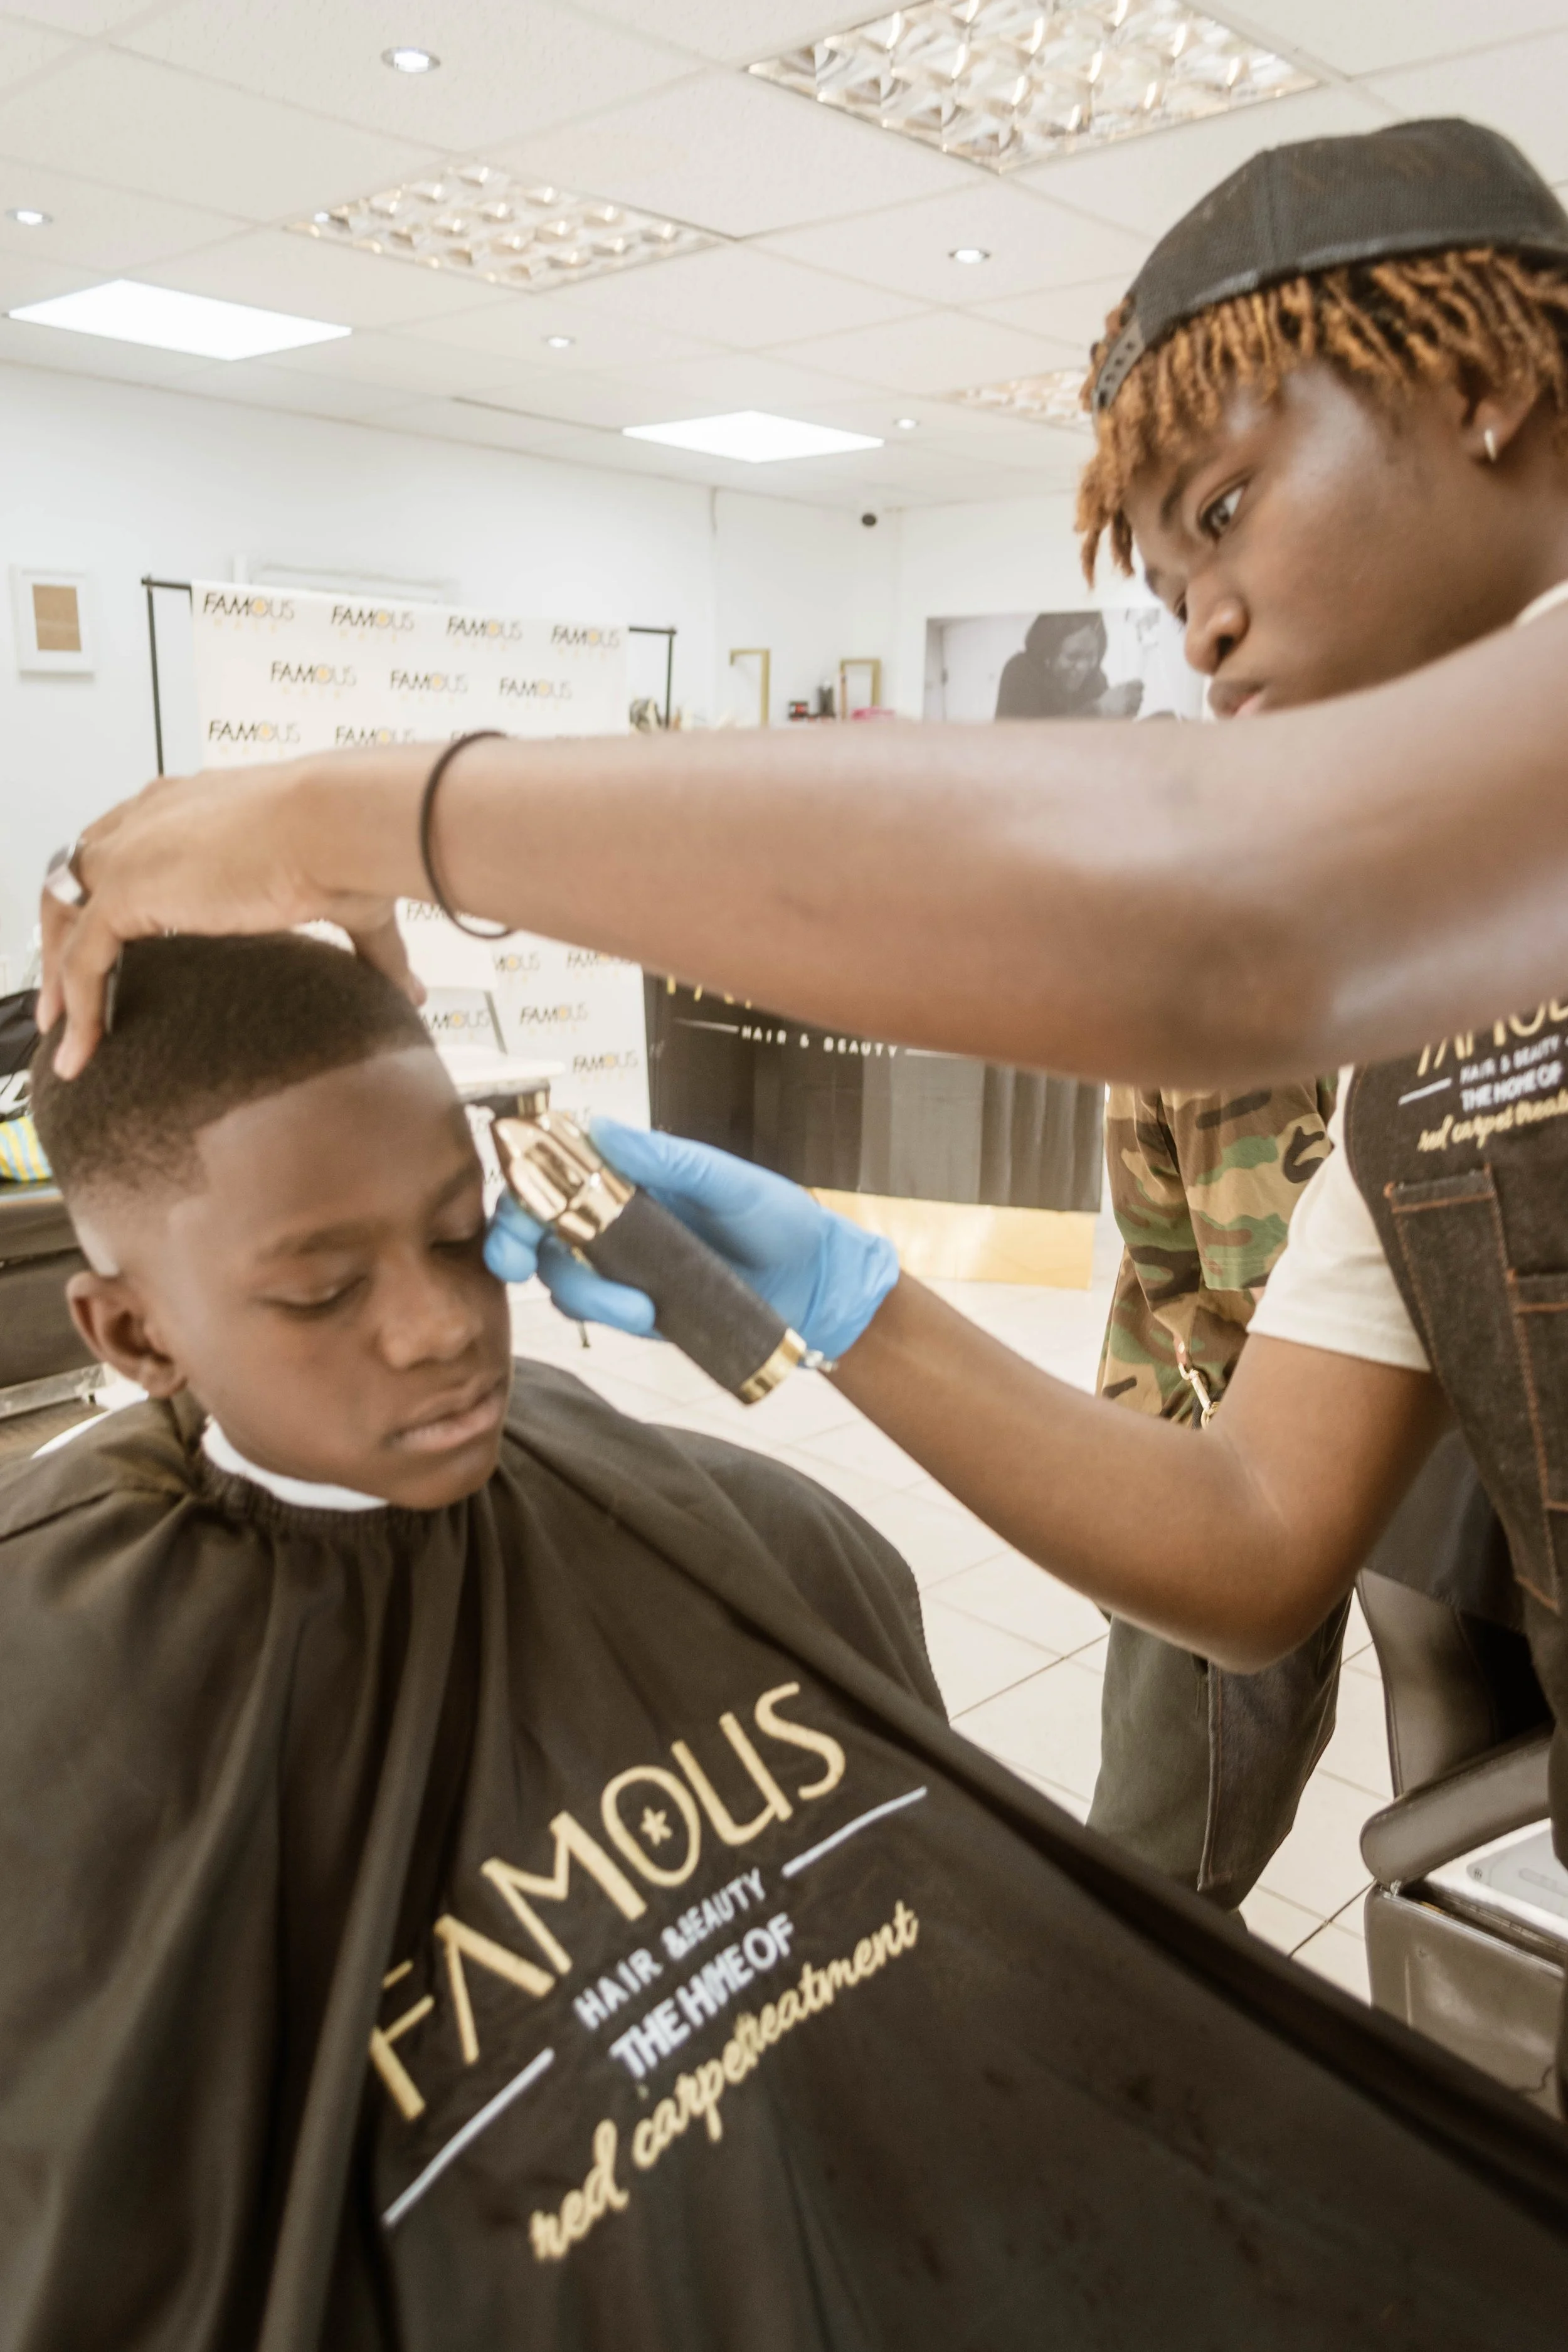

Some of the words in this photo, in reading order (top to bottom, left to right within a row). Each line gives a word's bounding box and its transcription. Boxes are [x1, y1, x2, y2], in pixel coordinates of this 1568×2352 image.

[203, 592, 295, 620] FAMOUS
[331, 605, 415, 631] FAMOUS
[446, 615, 522, 640] FAMOUS
[551, 625, 620, 649] FAMOUS
[270, 660, 357, 687] FAMOUS
[390, 669, 468, 694] FAMOUS
[499, 676, 572, 700] FAMOUS
[208, 719, 300, 744] FAMOUS
[492, 951, 541, 972] MOUS
[519, 1003, 588, 1025] FAMOUS
[741, 1025, 787, 1045] HAIR
[799, 1032, 809, 1049] &
[823, 1036, 898, 1059] BEAUTY
[573, 1050, 638, 1074] FAMOUS
[369, 1681, 845, 2121] FAMOUS
[573, 1947, 665, 2031] HAIR
[660, 1925, 691, 1961] &
[608, 1996, 692, 2080] THE
[674, 1942, 755, 2028] HME
[742, 1911, 795, 1971] OF
[530, 2119, 628, 2262] red
[738, 1899, 920, 2054] reatment
